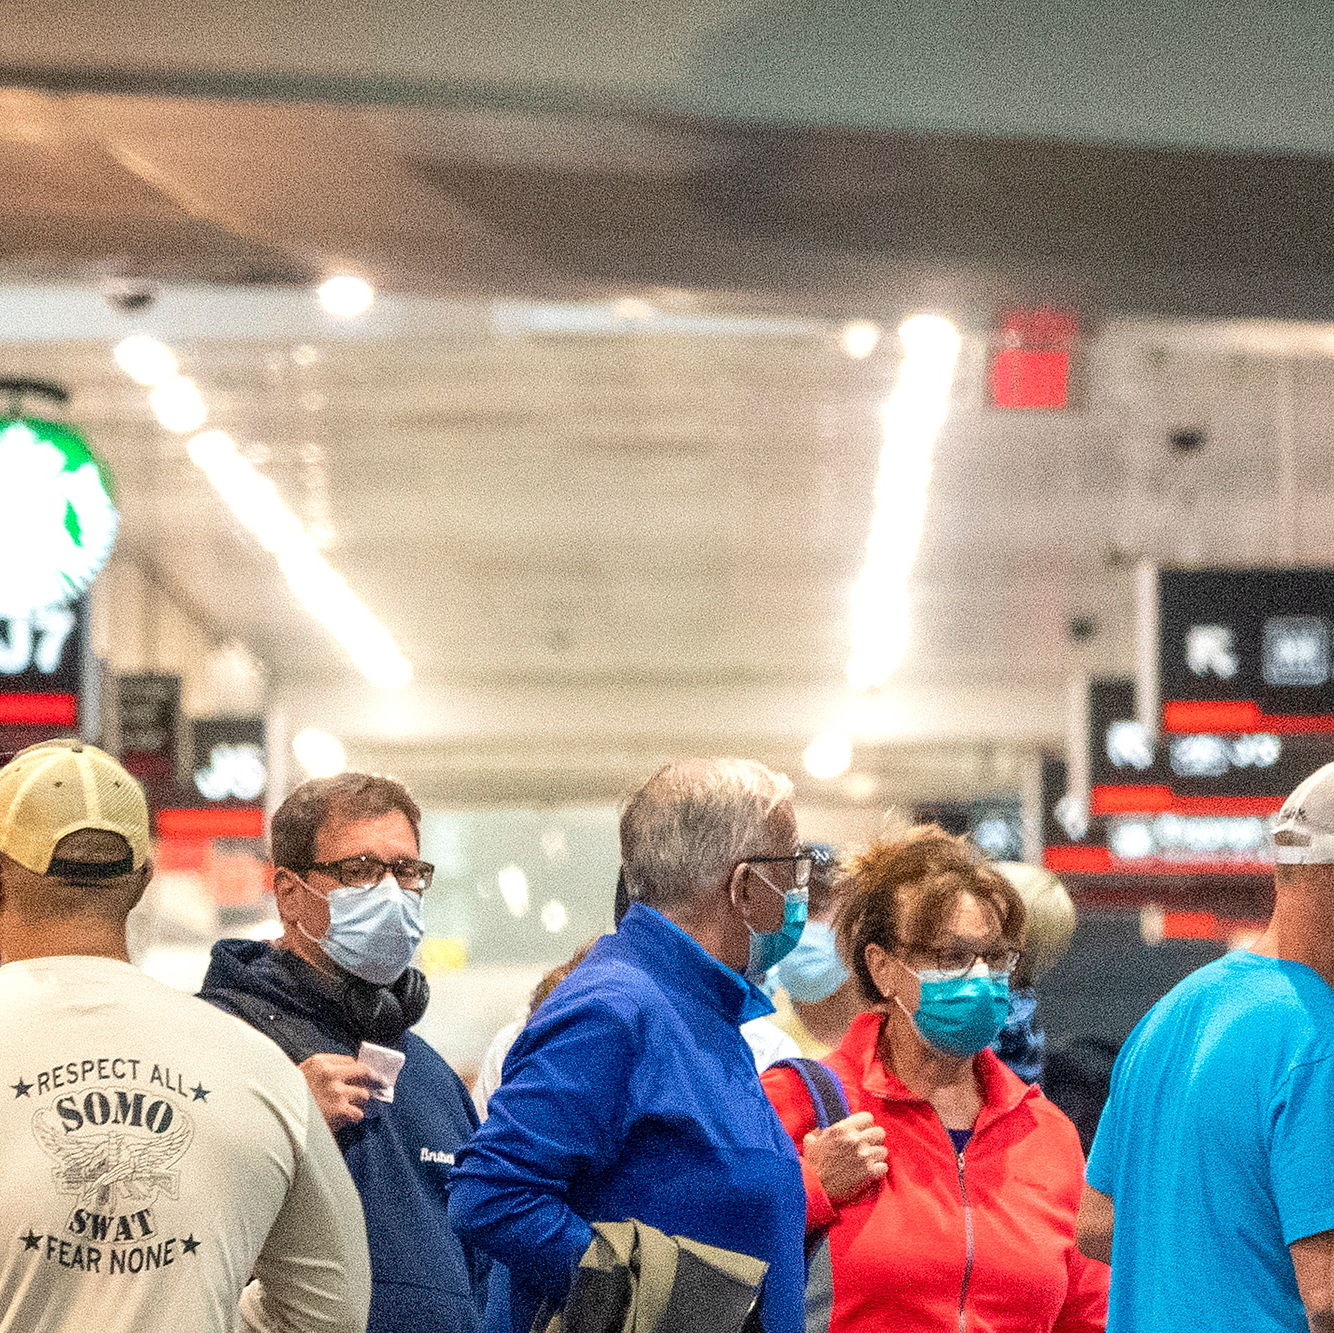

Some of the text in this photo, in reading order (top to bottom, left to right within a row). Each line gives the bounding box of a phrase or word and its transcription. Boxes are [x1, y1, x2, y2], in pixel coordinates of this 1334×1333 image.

[37, 1058, 188, 1097] RESPECT ALL
[56, 1091, 174, 1134] SOMO
[69, 1208, 155, 1242] SWAT
[45, 1235, 177, 1275] FEAR NONE
